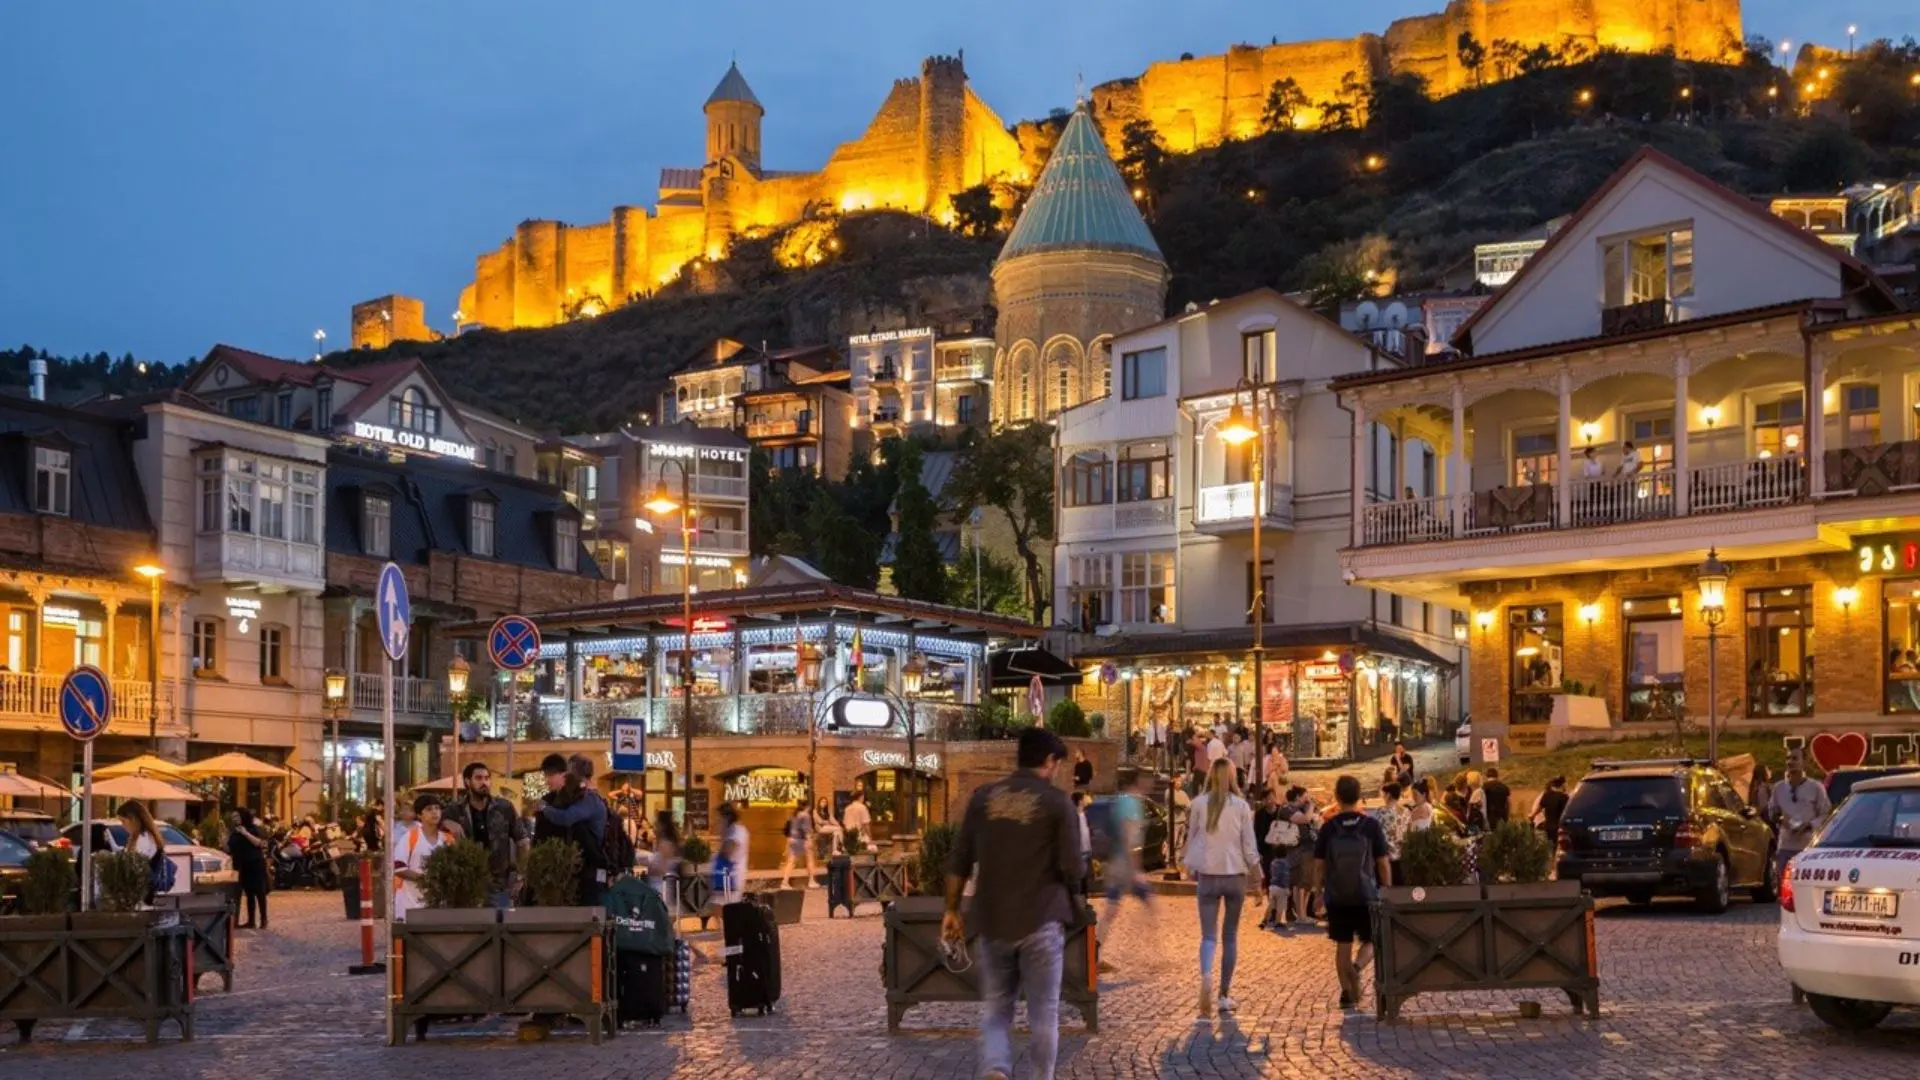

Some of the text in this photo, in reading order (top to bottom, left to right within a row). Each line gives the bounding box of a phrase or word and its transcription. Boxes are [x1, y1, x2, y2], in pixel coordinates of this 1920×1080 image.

[355, 422, 475, 460] HOTEL OLD MEIDAN
[700, 449, 744, 462] HOTEL
[1832, 895, 1888, 912] AH-911-HA
